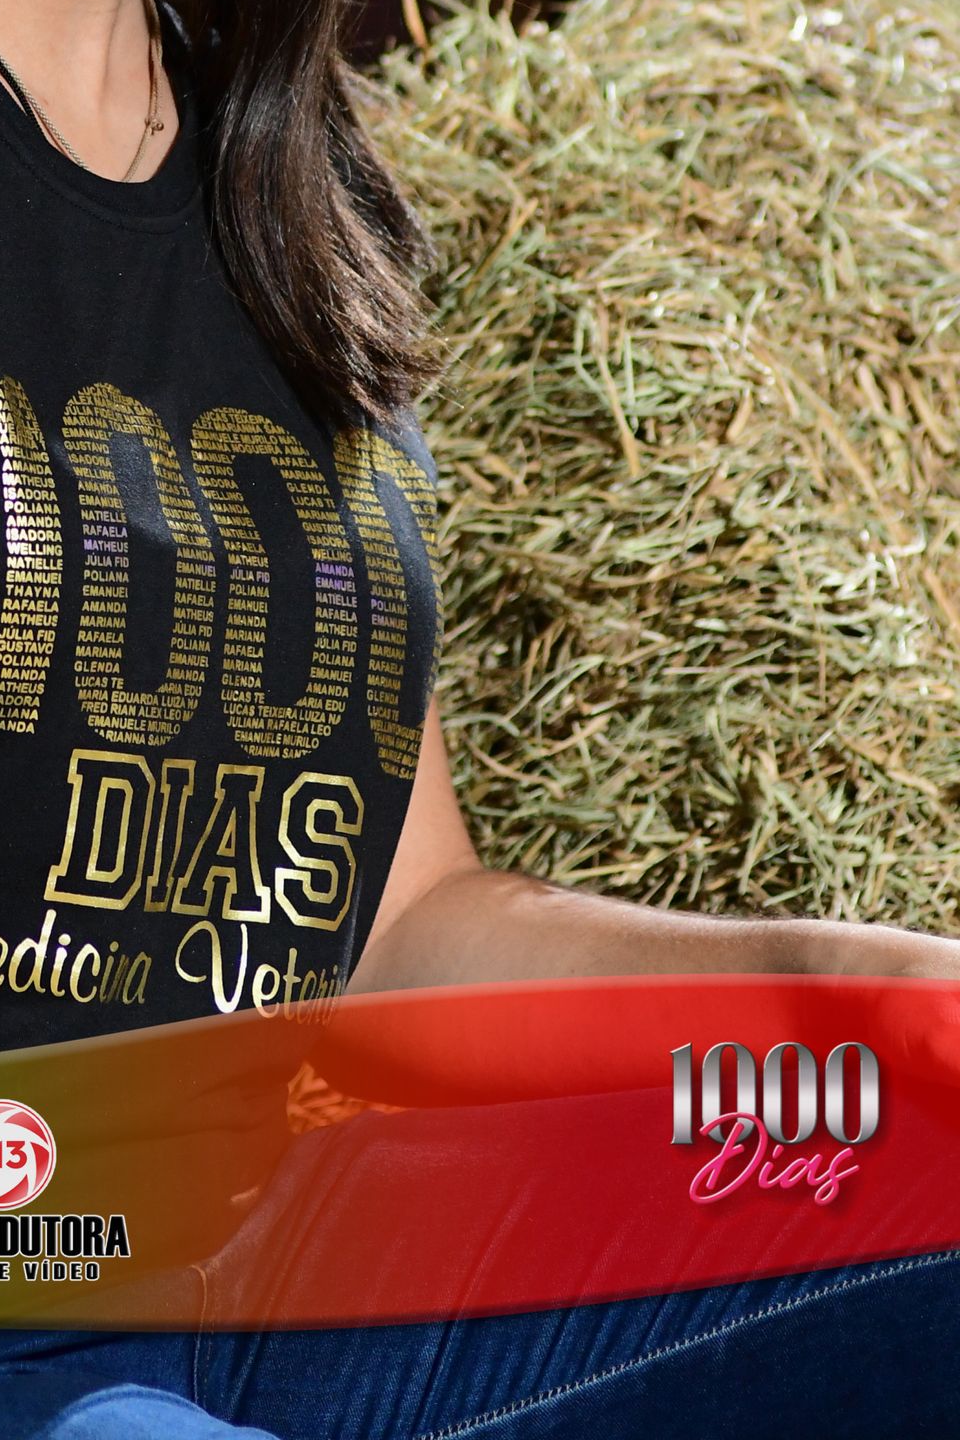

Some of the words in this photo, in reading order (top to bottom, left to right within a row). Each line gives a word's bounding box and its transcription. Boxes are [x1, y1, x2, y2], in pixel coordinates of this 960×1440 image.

[0, 446, 49, 462] WELLING
[2, 459, 52, 475] AMANDA
[2, 473, 55, 488] MATHEUS
[3, 487, 57, 501] ISADORA
[4, 501, 60, 514] POLIANA
[7, 515, 61, 528] AMANDA
[81, 510, 127, 524] NATIELLE
[6, 528, 62, 542] ISADORA
[83, 524, 128, 538] RAFAELA
[302, 521, 346, 536] GUSTAVO
[7, 542, 63, 556] WELLING
[84, 539, 128, 553] MATHEUS
[307, 535, 350, 548] ISADORA
[85, 552, 112, 567] JÚLIA
[115, 556, 129, 568] FID
[176, 547, 215, 562] AMANDA
[312, 548, 353, 563] WELLING
[7, 556, 63, 570] NATIELLE
[315, 563, 354, 578] AMANDA
[84, 570, 129, 583] POLIANA
[5, 584, 60, 598] THAYNA
[175, 577, 217, 593] NATIELLE
[229, 583, 270, 598] POLIANA
[3, 598, 59, 612] RAFAELA
[82, 600, 127, 614] AMANDA
[174, 592, 214, 607] RAFAELA
[315, 592, 357, 608] NATIELLE
[1, 612, 58, 627] MATHEUS
[80, 615, 126, 628] MARIANA
[173, 607, 214, 622] MATHEUS
[227, 614, 267, 628] AMANDA
[315, 607, 358, 623] RAFAELA
[0, 625, 34, 641] JÚLIA
[37, 630, 56, 642] FID
[78, 630, 124, 644] RAFAELA
[225, 628, 266, 643] MARIANA
[315, 622, 358, 637] MATHEUS
[75, 645, 122, 659] MARIANA
[171, 637, 210, 652] POLIANA
[224, 643, 264, 658] RAFAELA
[74, 661, 120, 674] GLENDA
[222, 658, 263, 674] MARIANA
[312, 652, 355, 668] POLIANA
[75, 676, 108, 688] LUCAS
[166, 668, 205, 682] AMANDA
[221, 673, 262, 688] GLENDA
[78, 689, 108, 701] MARIA
[111, 691, 158, 706] EDUARDA
[221, 689, 251, 704] LUCAS
[306, 682, 349, 698] AMANDA
[81, 701, 108, 714] FRED
[110, 703, 136, 716] RIAN
[223, 703, 255, 717] LUCAS
[258, 705, 297, 720] TEIXEIRA
[299, 709, 325, 722] LUIZA
[325, 699, 345, 713] EDU
[87, 715, 146, 731] EMANUELE
[227, 716, 264, 730] JULIANA
[266, 718, 309, 734] RAFAELA
[310, 724, 332, 737] LEO
[234, 730, 282, 745] EMANUELE
[283, 734, 320, 749] MURILO
[43, 748, 365, 931] DIAS
